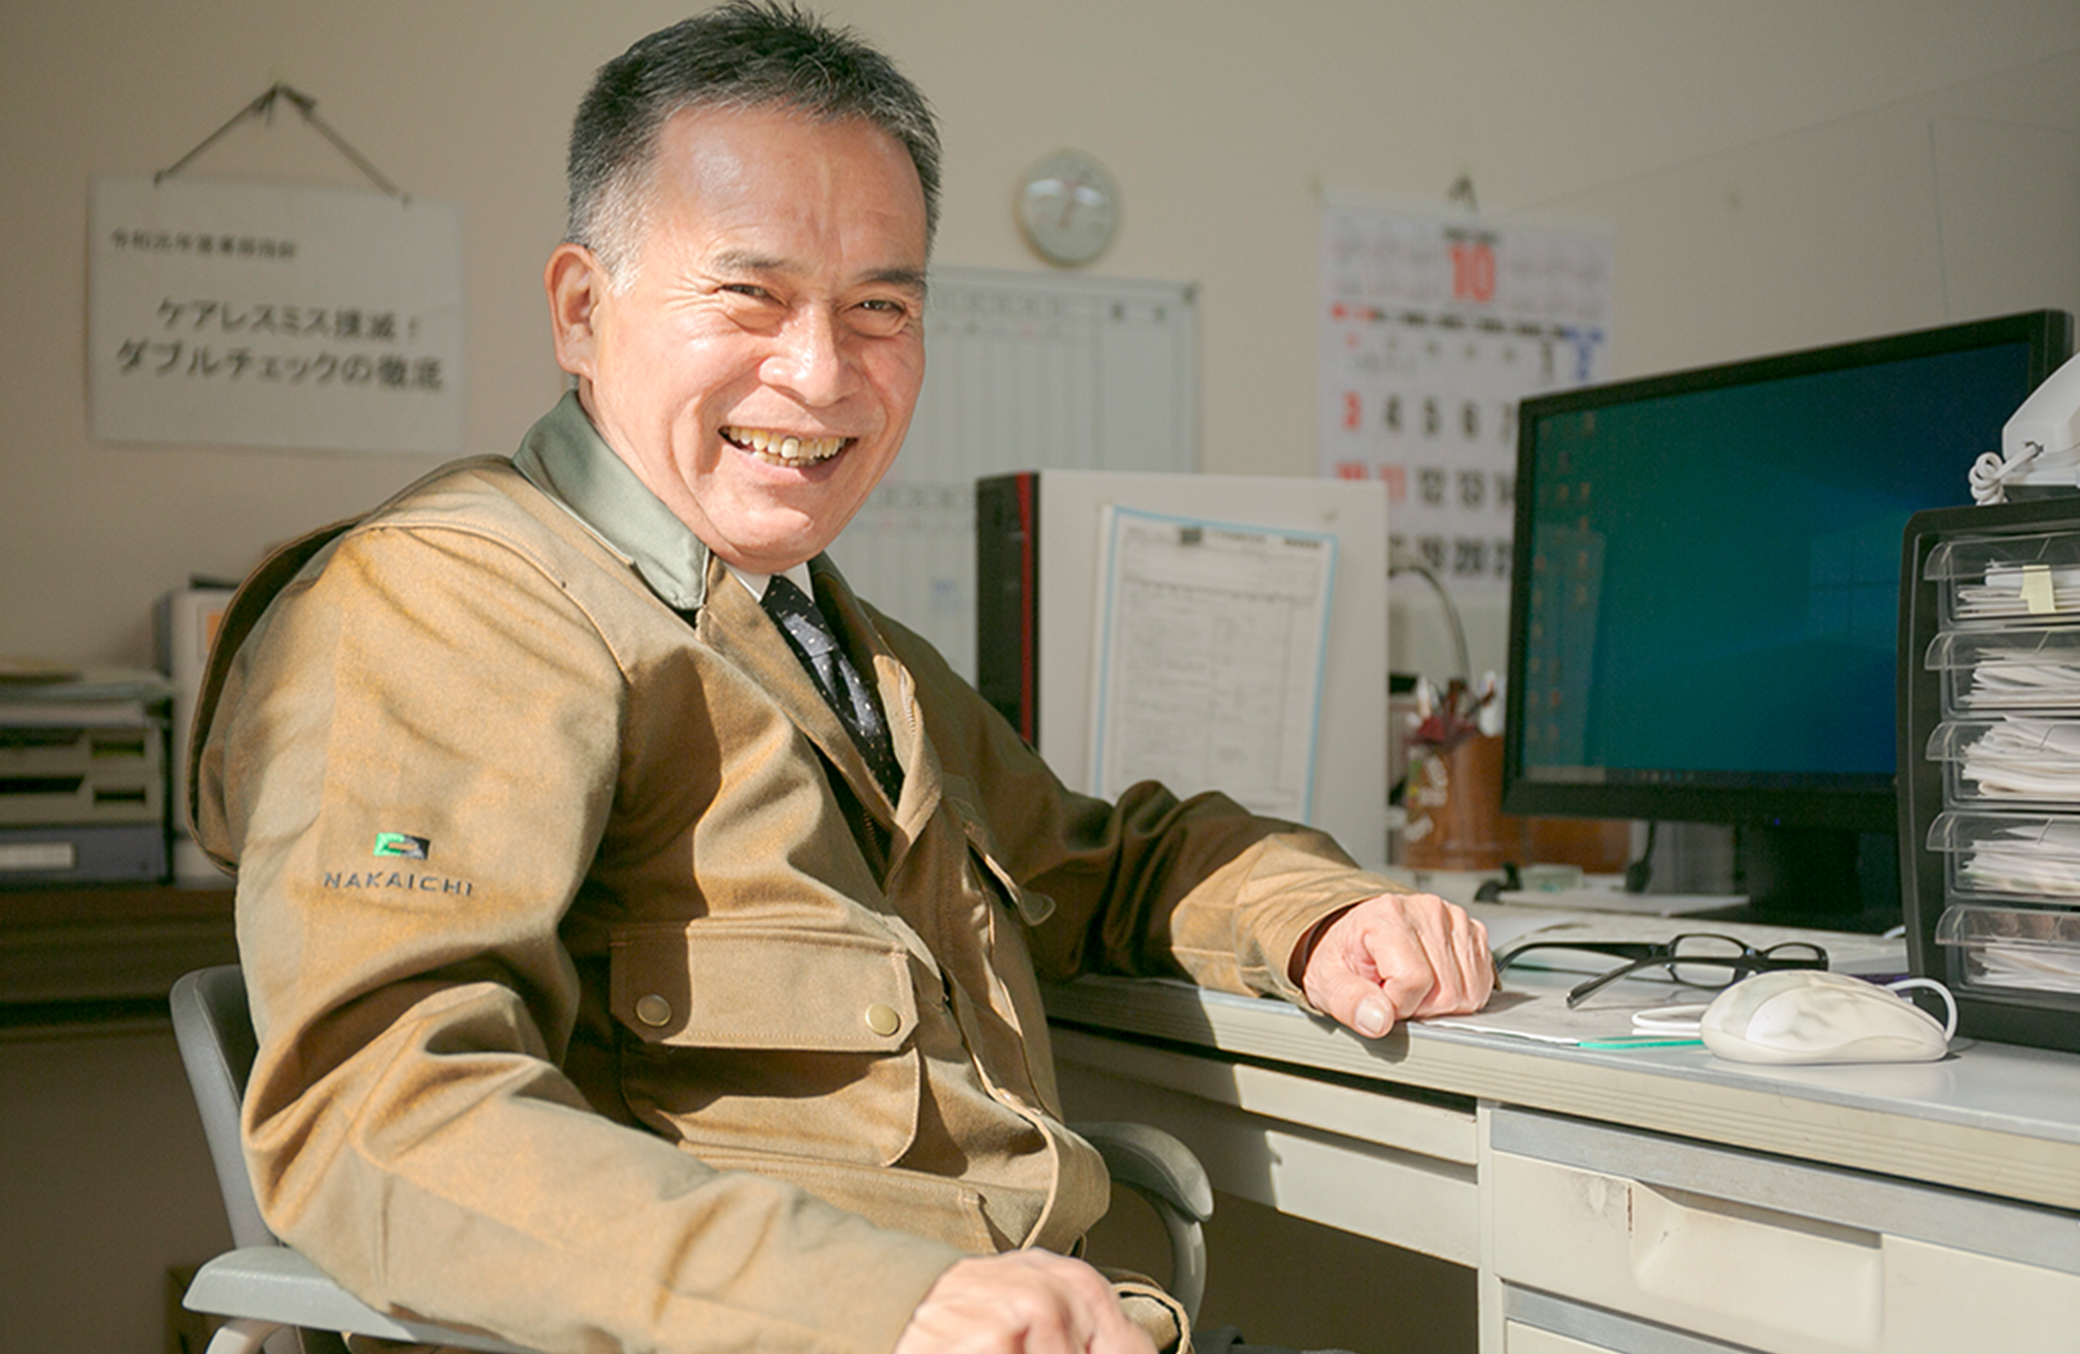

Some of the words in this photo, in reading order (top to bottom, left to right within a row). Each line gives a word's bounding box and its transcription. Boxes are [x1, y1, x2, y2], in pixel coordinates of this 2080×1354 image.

[1449, 242, 1496, 302] 10
[116, 337, 444, 390] ダブルチェックの徹底
[324, 871, 473, 896] NAKAICHI
